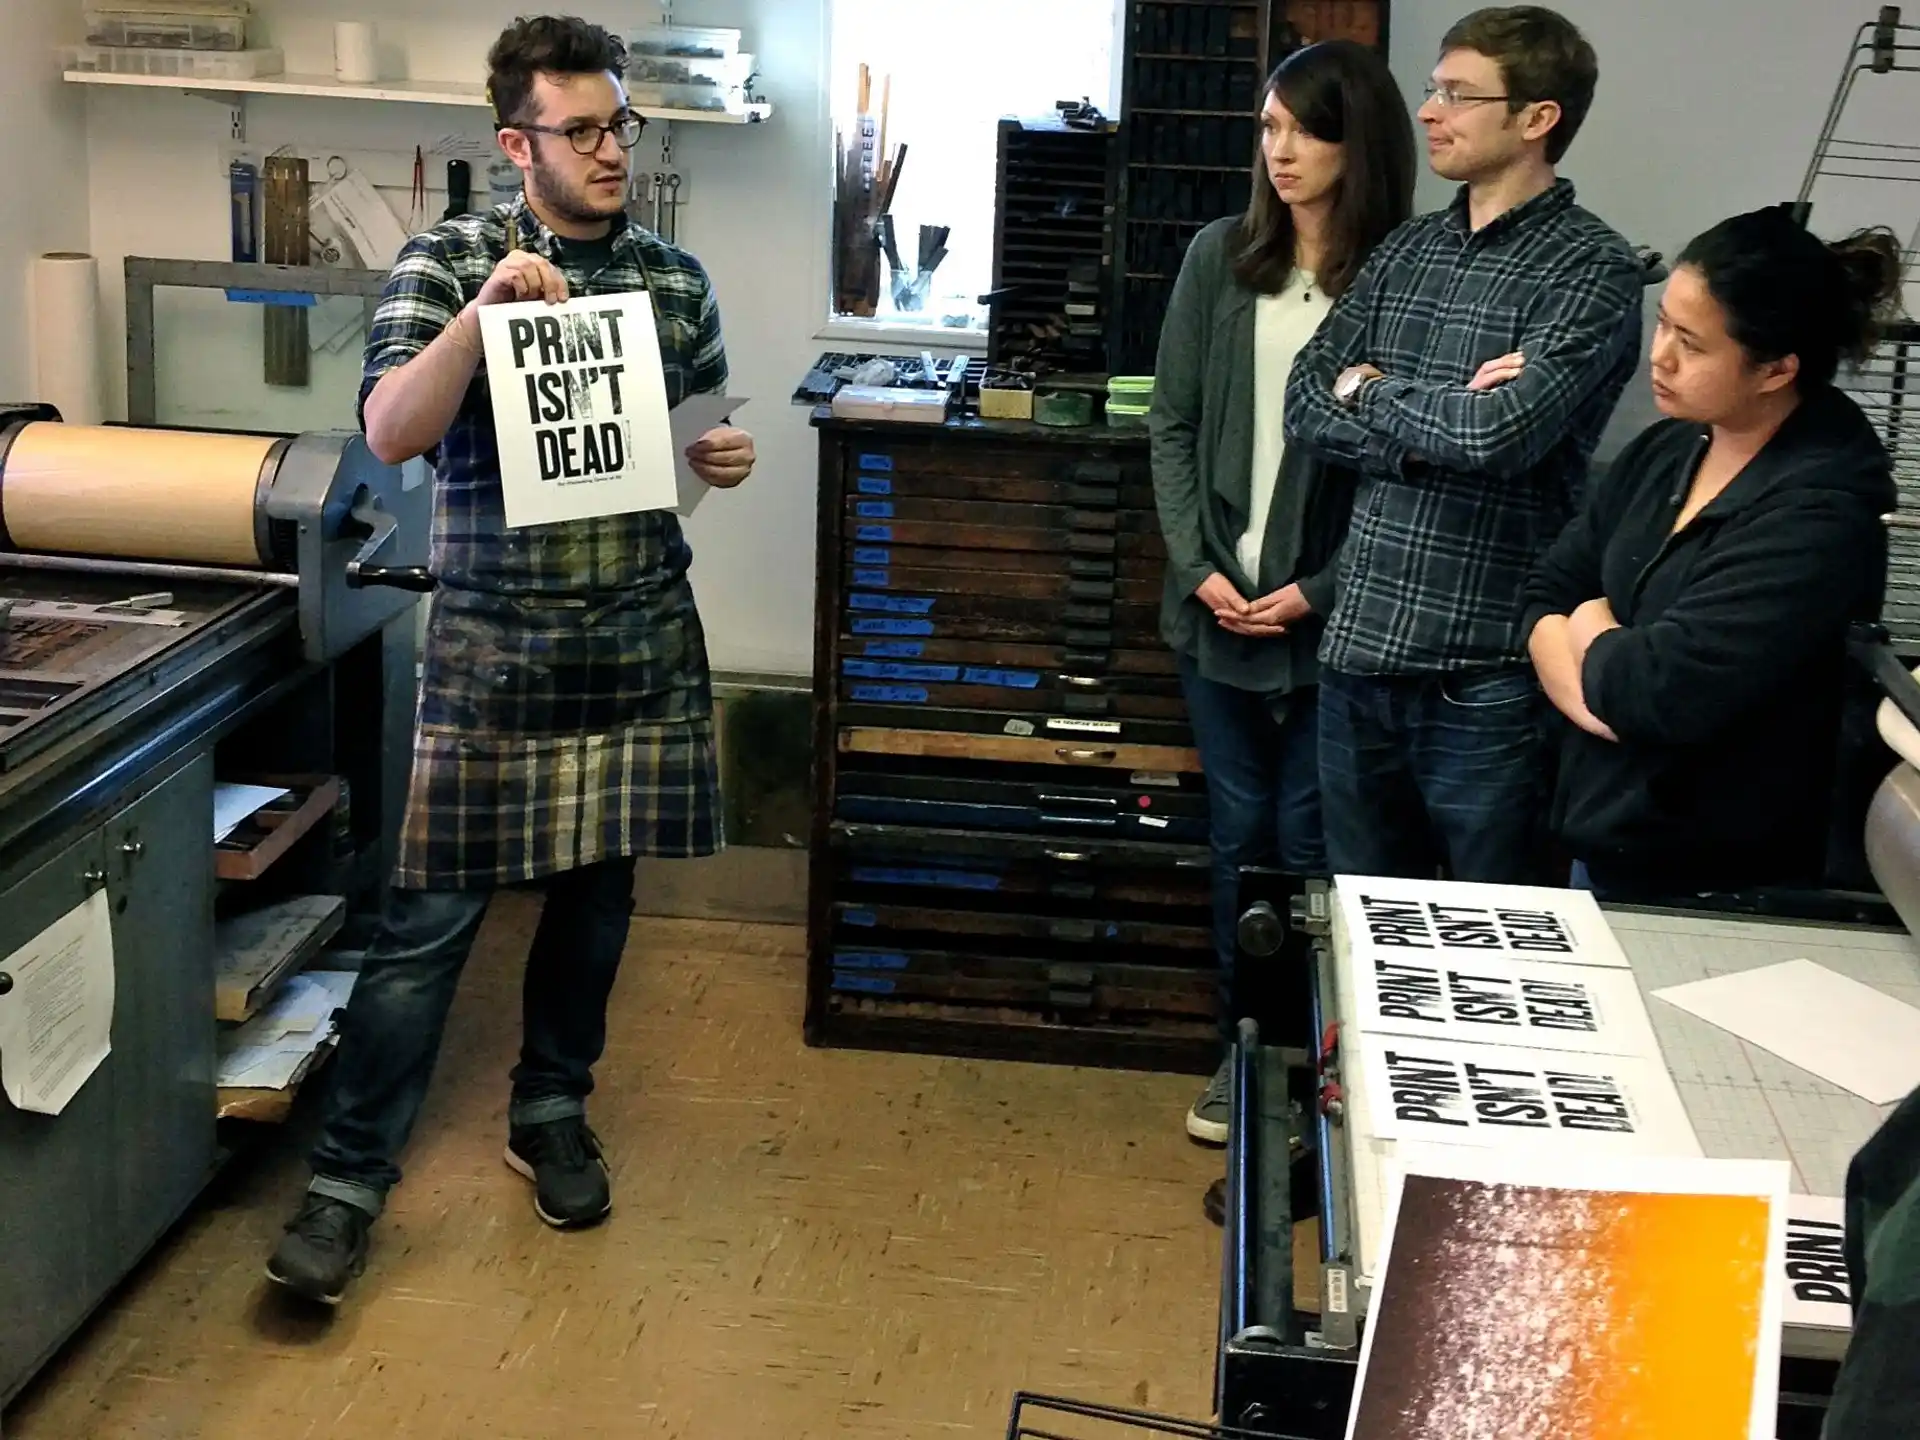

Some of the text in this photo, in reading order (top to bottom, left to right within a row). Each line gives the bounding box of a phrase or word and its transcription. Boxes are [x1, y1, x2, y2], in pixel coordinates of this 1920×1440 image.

[508, 308, 624, 368] PRINT
[524, 364, 625, 425] ISN'T
[1360, 894, 1435, 949] PRINT
[1427, 902, 1504, 950] ISN'T
[1494, 908, 1574, 953] DEAD!
[1374, 959, 1447, 1023] PRINT
[1447, 970, 1522, 1026] ISN'T
[1384, 1050, 1469, 1127] PRINT
[1464, 1062, 1552, 1128] ISN'T
